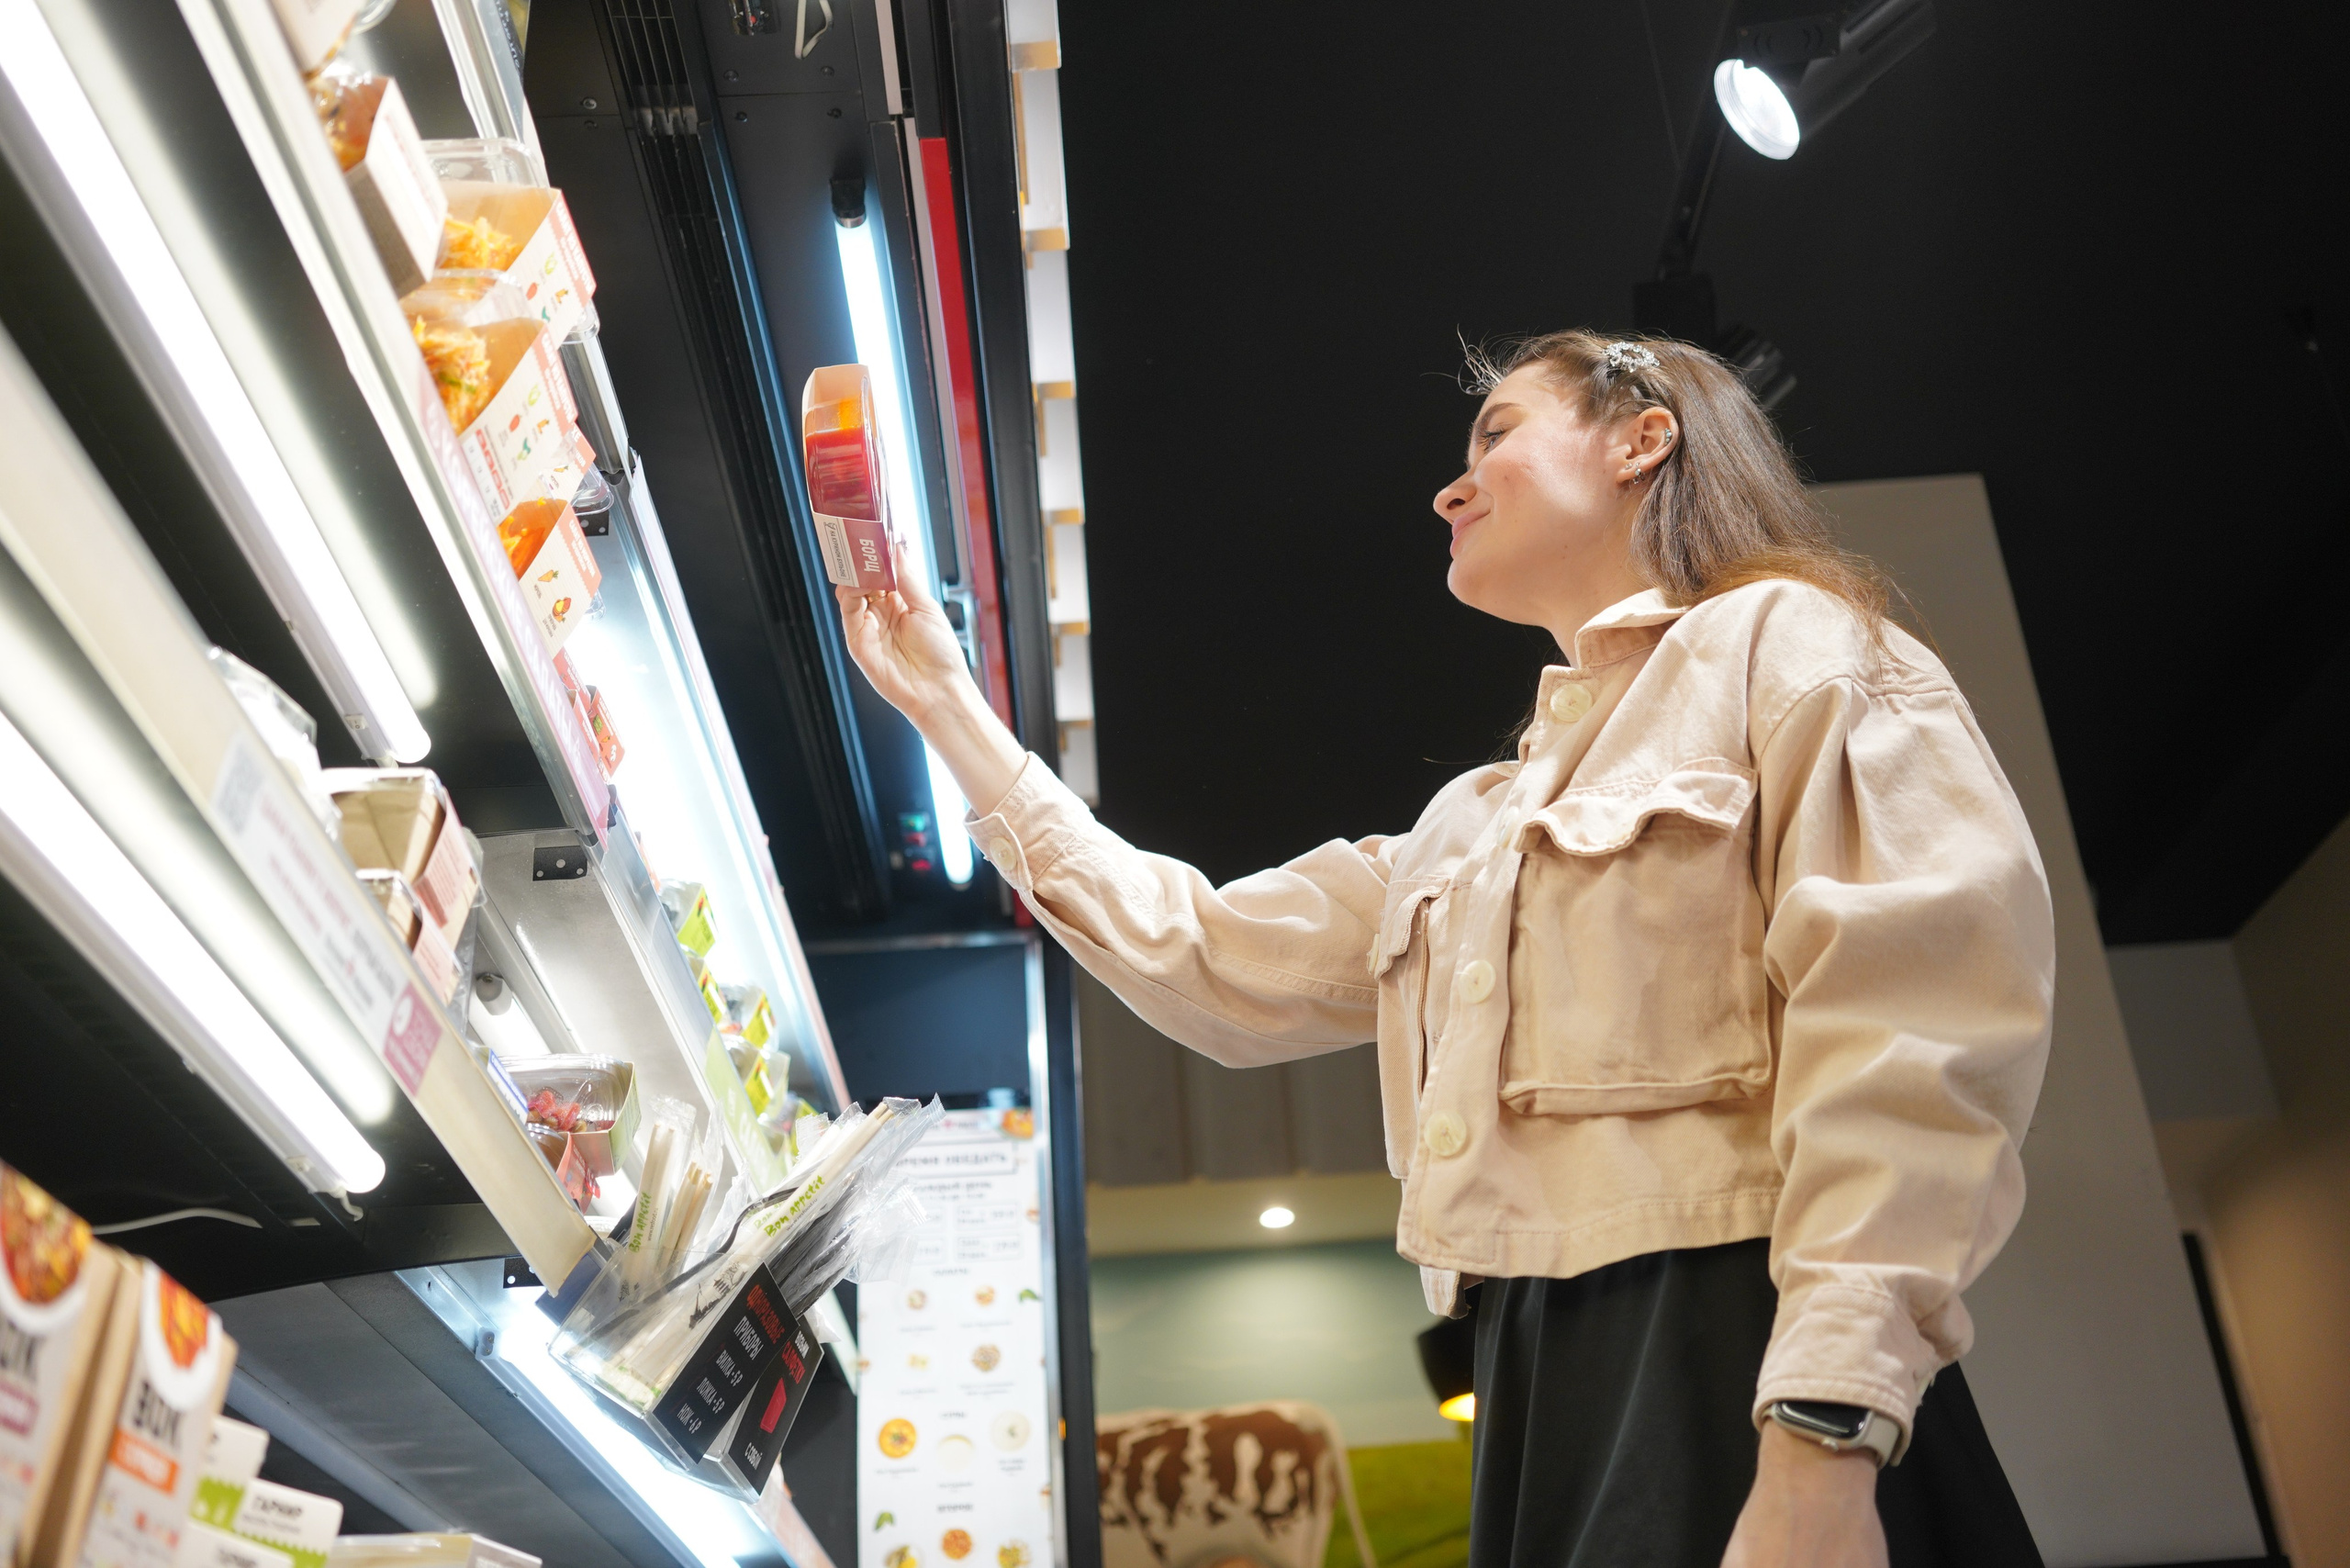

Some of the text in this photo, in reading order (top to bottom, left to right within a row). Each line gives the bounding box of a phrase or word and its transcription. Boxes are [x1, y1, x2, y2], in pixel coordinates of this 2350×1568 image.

[569, 519, 581, 543] САЛАТ
[581, 546, 596, 578] МОРКОВИ
[831, 536, 841, 560] КУРИНОМ
[837, 558, 846, 577] БУЛЬОНЕ
[859, 538, 880, 573] БОРЩ
[629, 1192, 652, 1253] Bon appetit
[764, 1175, 825, 1237] Bon appetit
[746, 1284, 785, 1344] ОДНОРАЗОВЫЕ
[733, 1316, 764, 1361] ПРИБОРЫ
[716, 1350, 735, 1378] ВИЛКА
[697, 1377, 717, 1406] ЛОЖКА
[677, 1403, 694, 1426] НОЖ
[746, 1446, 763, 1470] СОБОЙ
